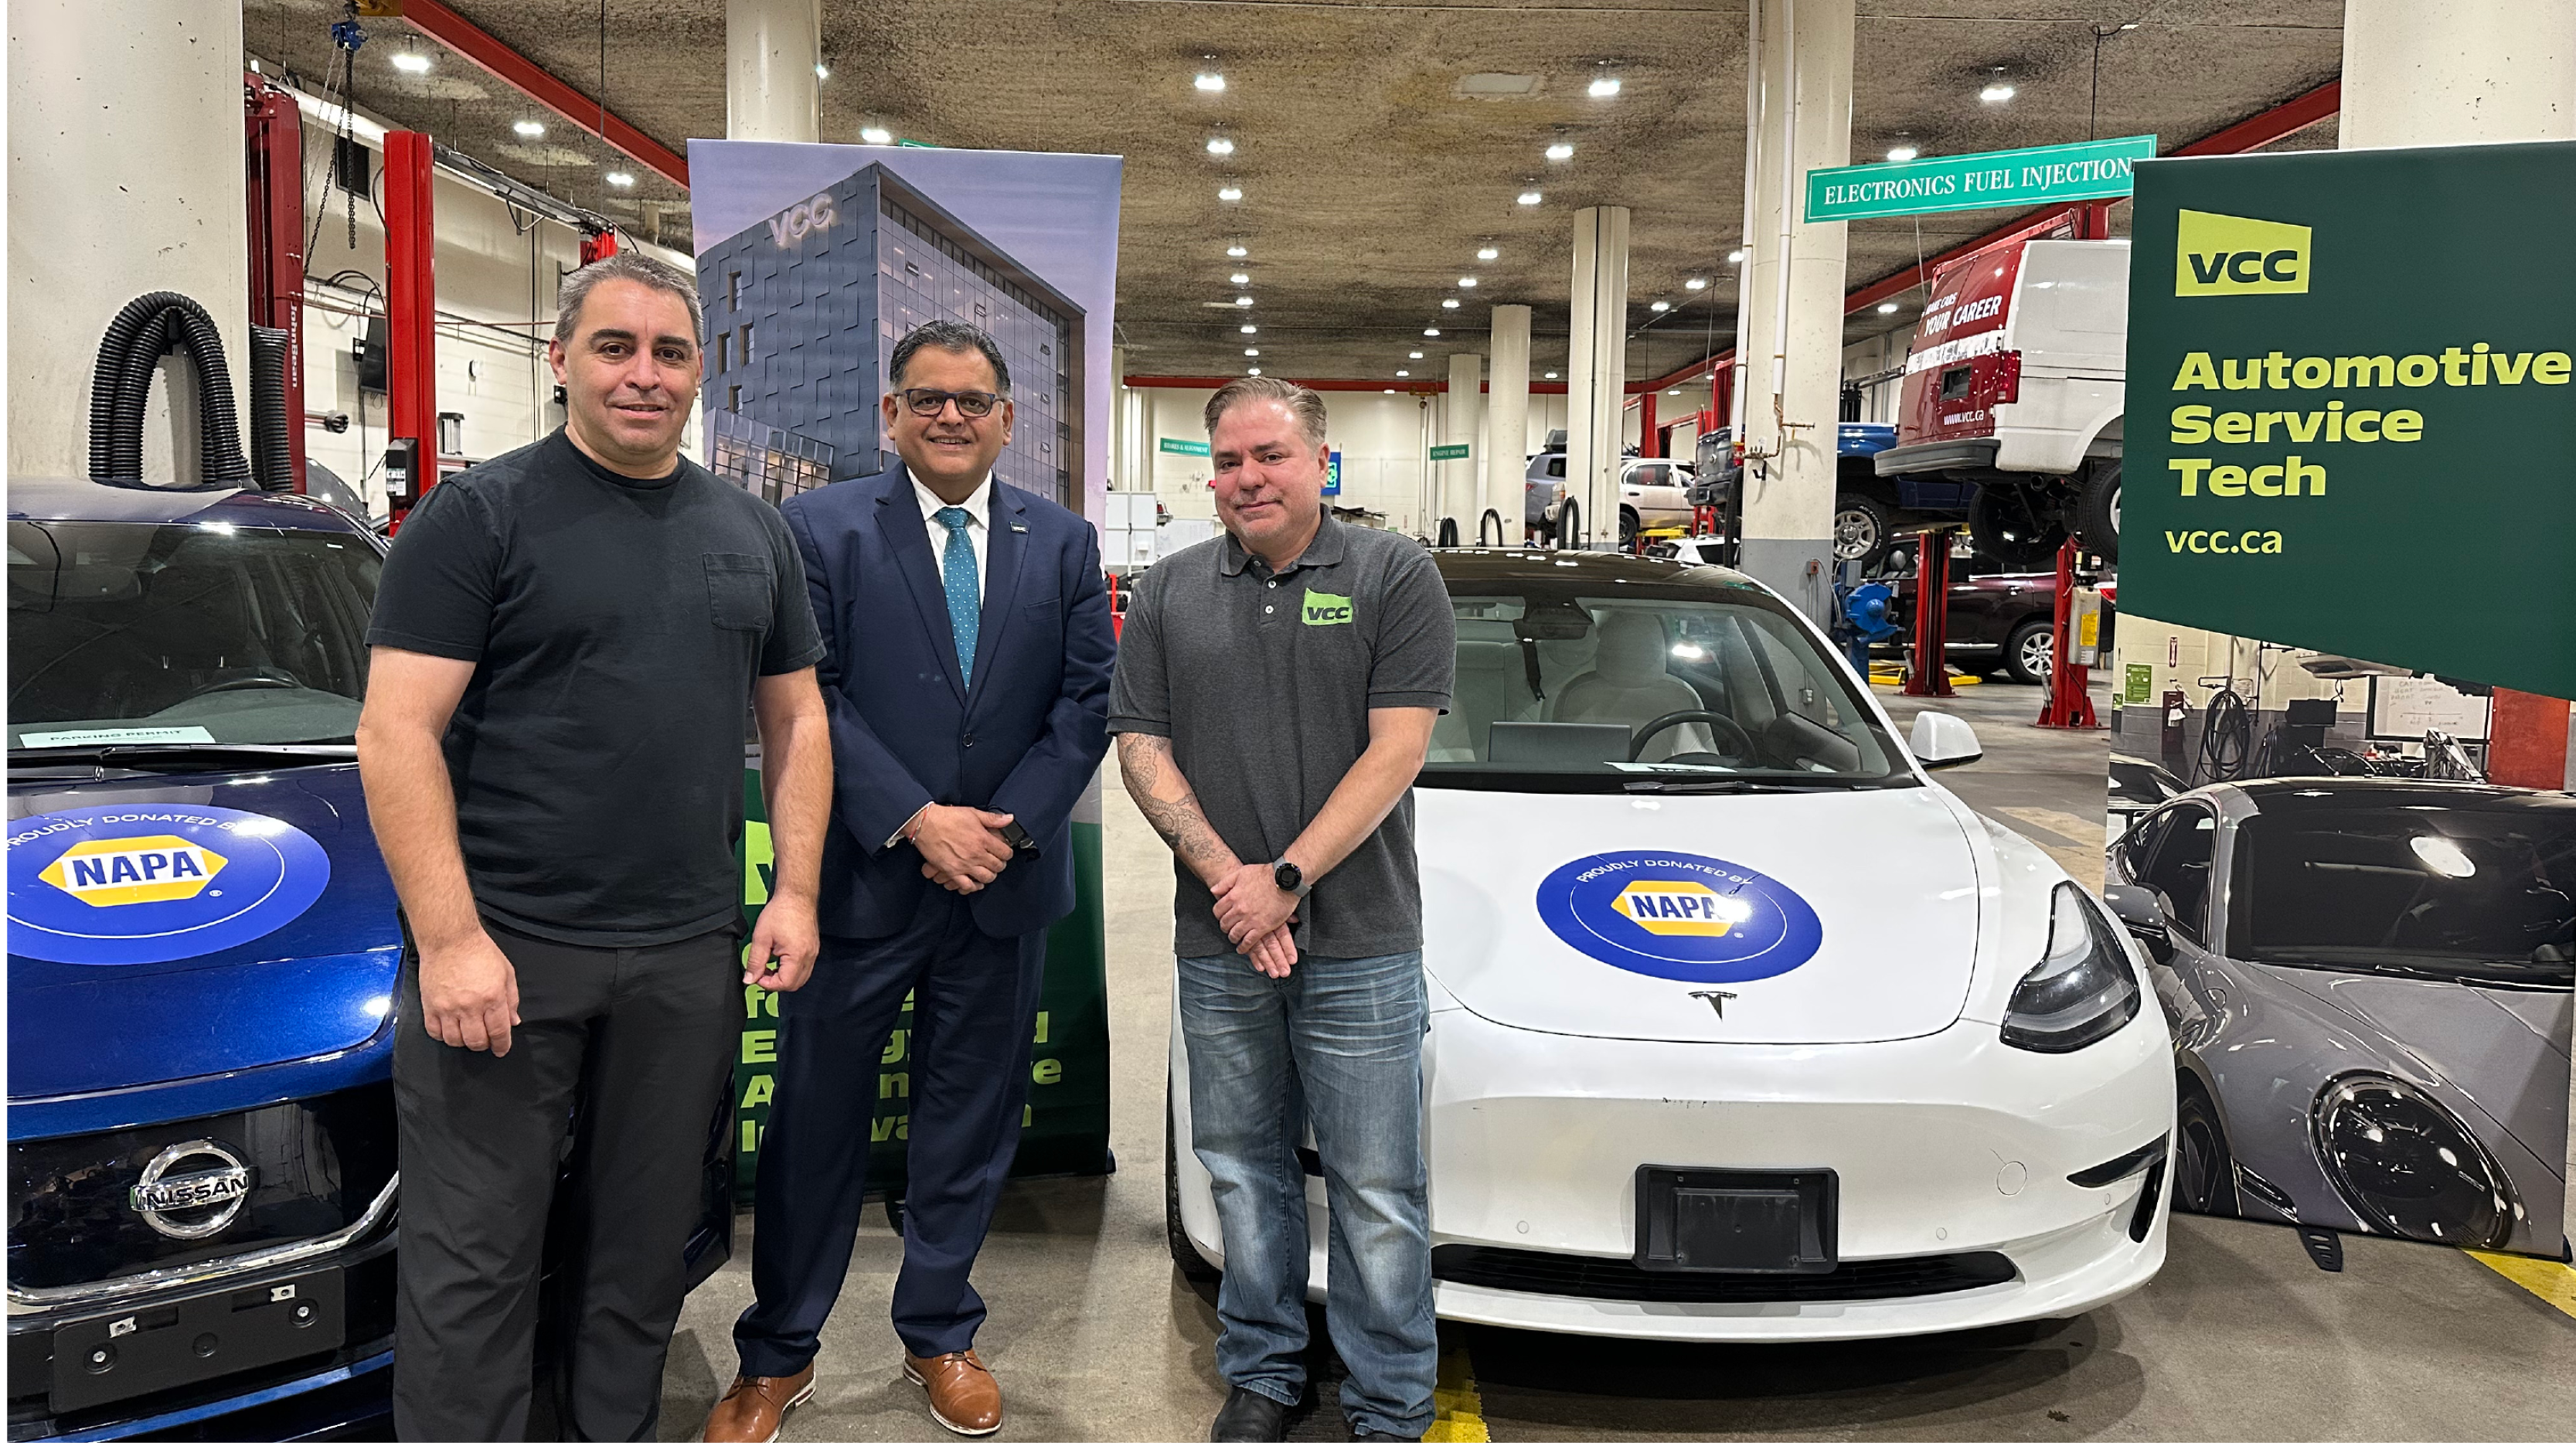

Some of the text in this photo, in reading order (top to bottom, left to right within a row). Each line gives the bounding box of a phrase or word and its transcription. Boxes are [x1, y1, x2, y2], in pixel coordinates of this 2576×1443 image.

[1824, 157, 2132, 205] ELECTRONICS FUEL INJECTION
[768, 192, 832, 243] VCC
[1924, 294, 2003, 337] YOUR CAREER
[2172, 342, 2572, 390] Automotive
[1943, 410, 1985, 426] www.vcc.ca
[2170, 400, 2424, 444] Service
[2168, 455, 2326, 496] Tech
[2165, 529, 2282, 554] vcc.ca
[50, 733, 122, 741] PARKING
[102, 814, 216, 827] DONATED
[72, 851, 202, 887] NAPA
[1576, 859, 1753, 885] PROUDLY DONATED BY
[147, 1176, 247, 1206] NISSAN
